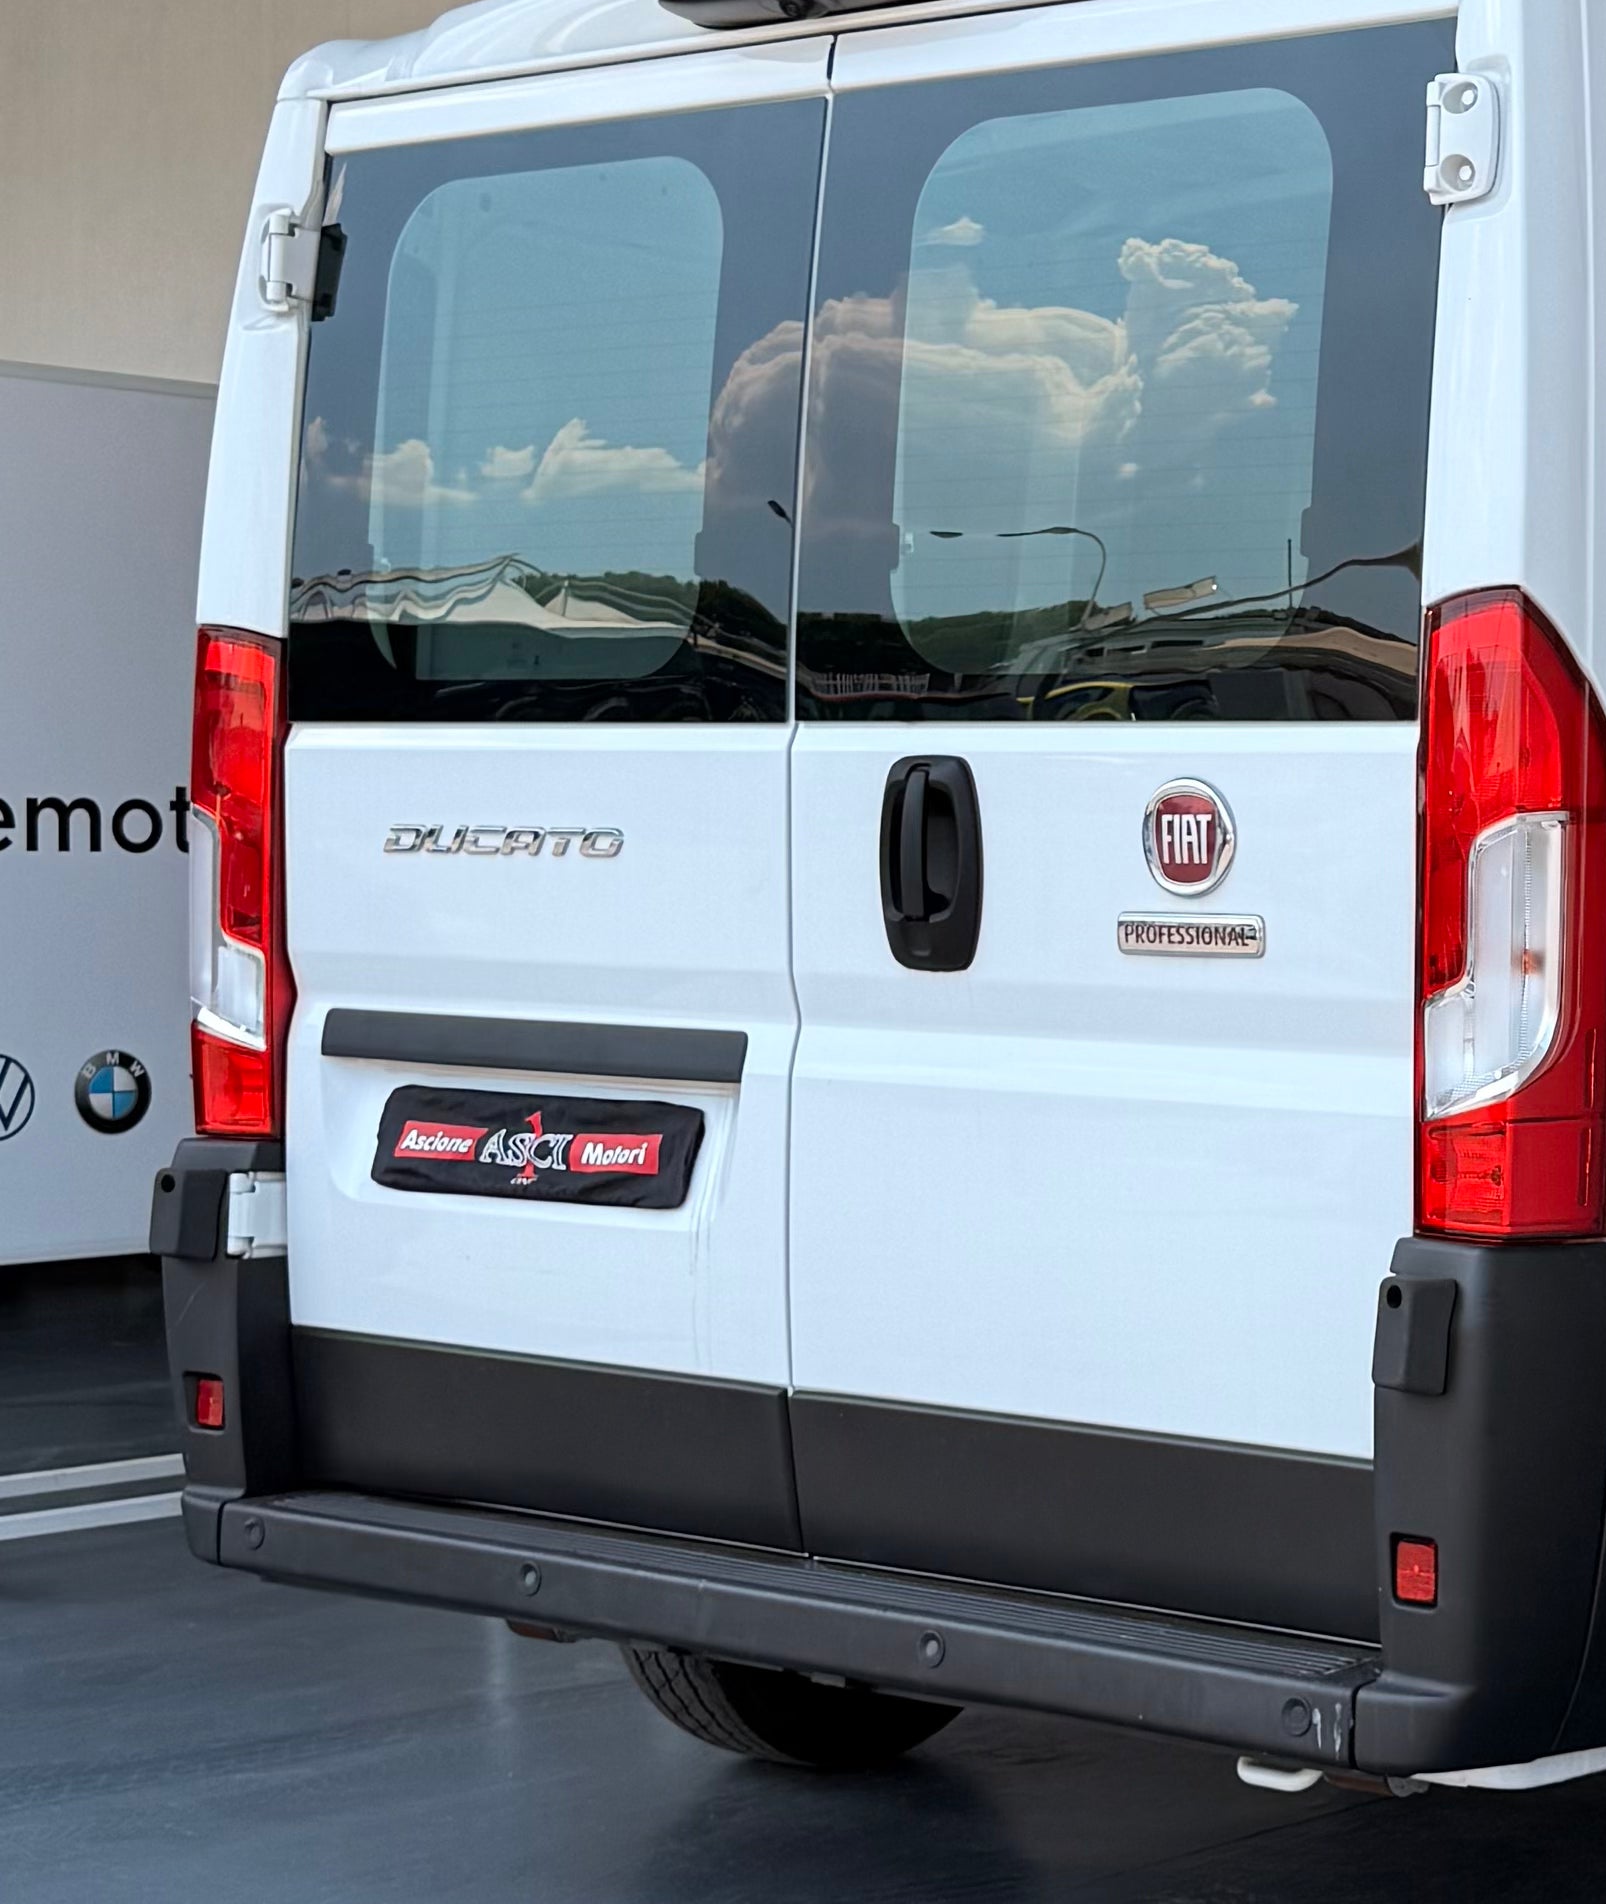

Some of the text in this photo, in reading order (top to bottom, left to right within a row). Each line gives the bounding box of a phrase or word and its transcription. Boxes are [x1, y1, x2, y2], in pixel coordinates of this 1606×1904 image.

[382, 823, 625, 859] DUCATO
[1160, 813, 1213, 865] FIAT
[1124, 923, 1251, 947] PROFESSIONAL
[82, 1051, 145, 1079] BMW
[399, 1128, 648, 1171] Ascione ASCI Motori
